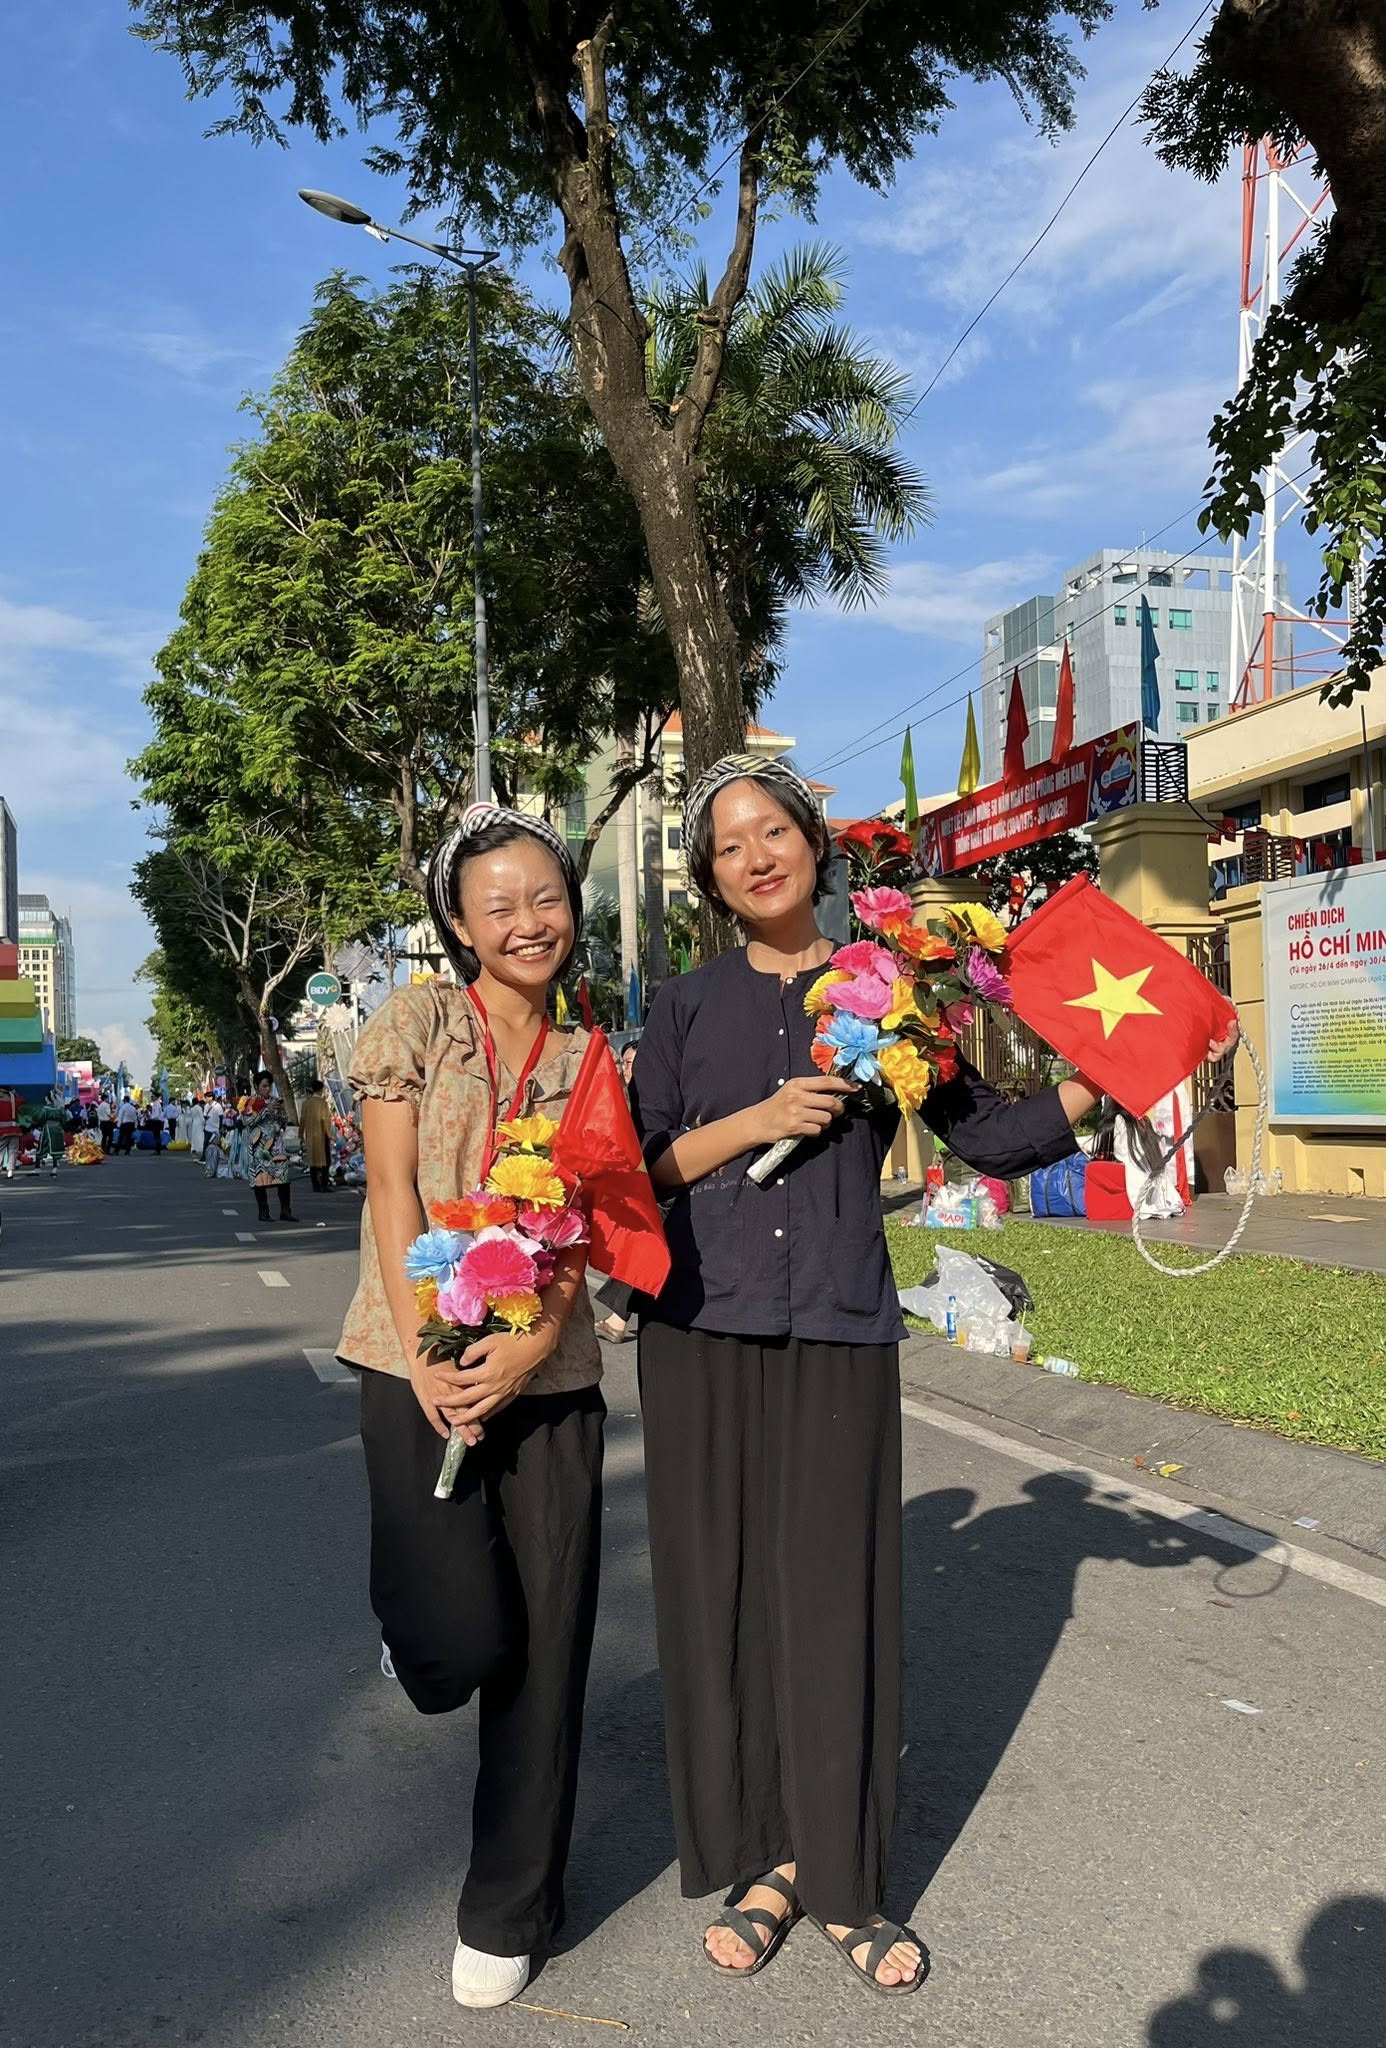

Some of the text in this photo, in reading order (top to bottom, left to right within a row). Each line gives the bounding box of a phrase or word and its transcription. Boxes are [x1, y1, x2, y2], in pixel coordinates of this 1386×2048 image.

[1288, 907, 1345, 931] CHIẾN DỊCH
[1289, 930, 1314, 961] HỒ
[1319, 928, 1351, 957] CHÍ
[1301, 963, 1316, 974] ngày
[1318, 962, 1334, 971] 26/4
[1335, 959, 1349, 969] đến
[1350, 959, 1367, 969] ngày
[310, 986, 330, 995] BIDV
